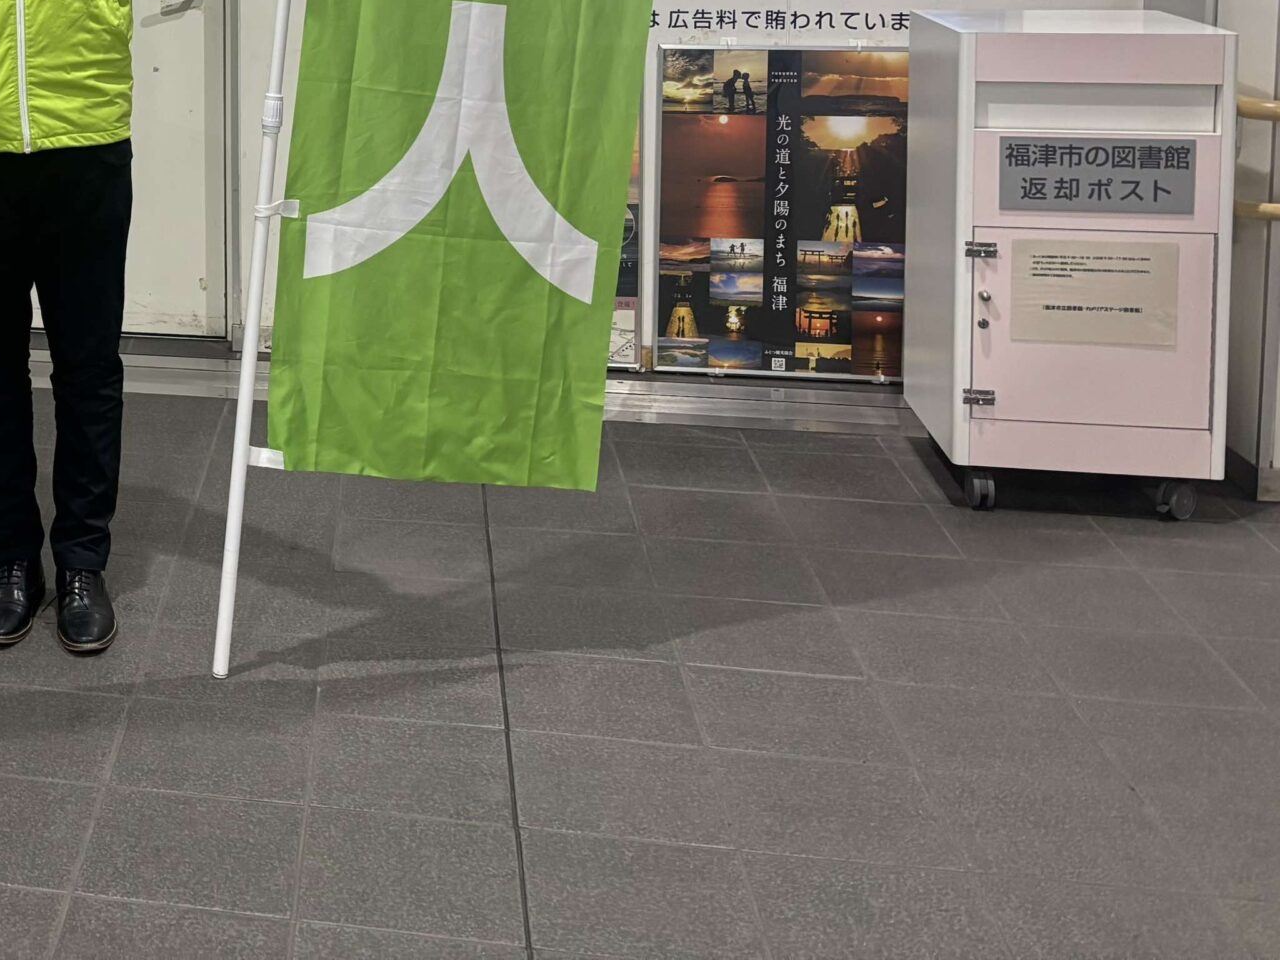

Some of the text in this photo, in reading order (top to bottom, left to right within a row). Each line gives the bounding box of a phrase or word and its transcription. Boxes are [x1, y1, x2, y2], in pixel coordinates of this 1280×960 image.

[1004, 143, 1191, 171] 福津市の図書館
[1020, 177, 1173, 203] 返却ポスト
[771, 114, 792, 311] 光の道と夕陽のまち 福津
